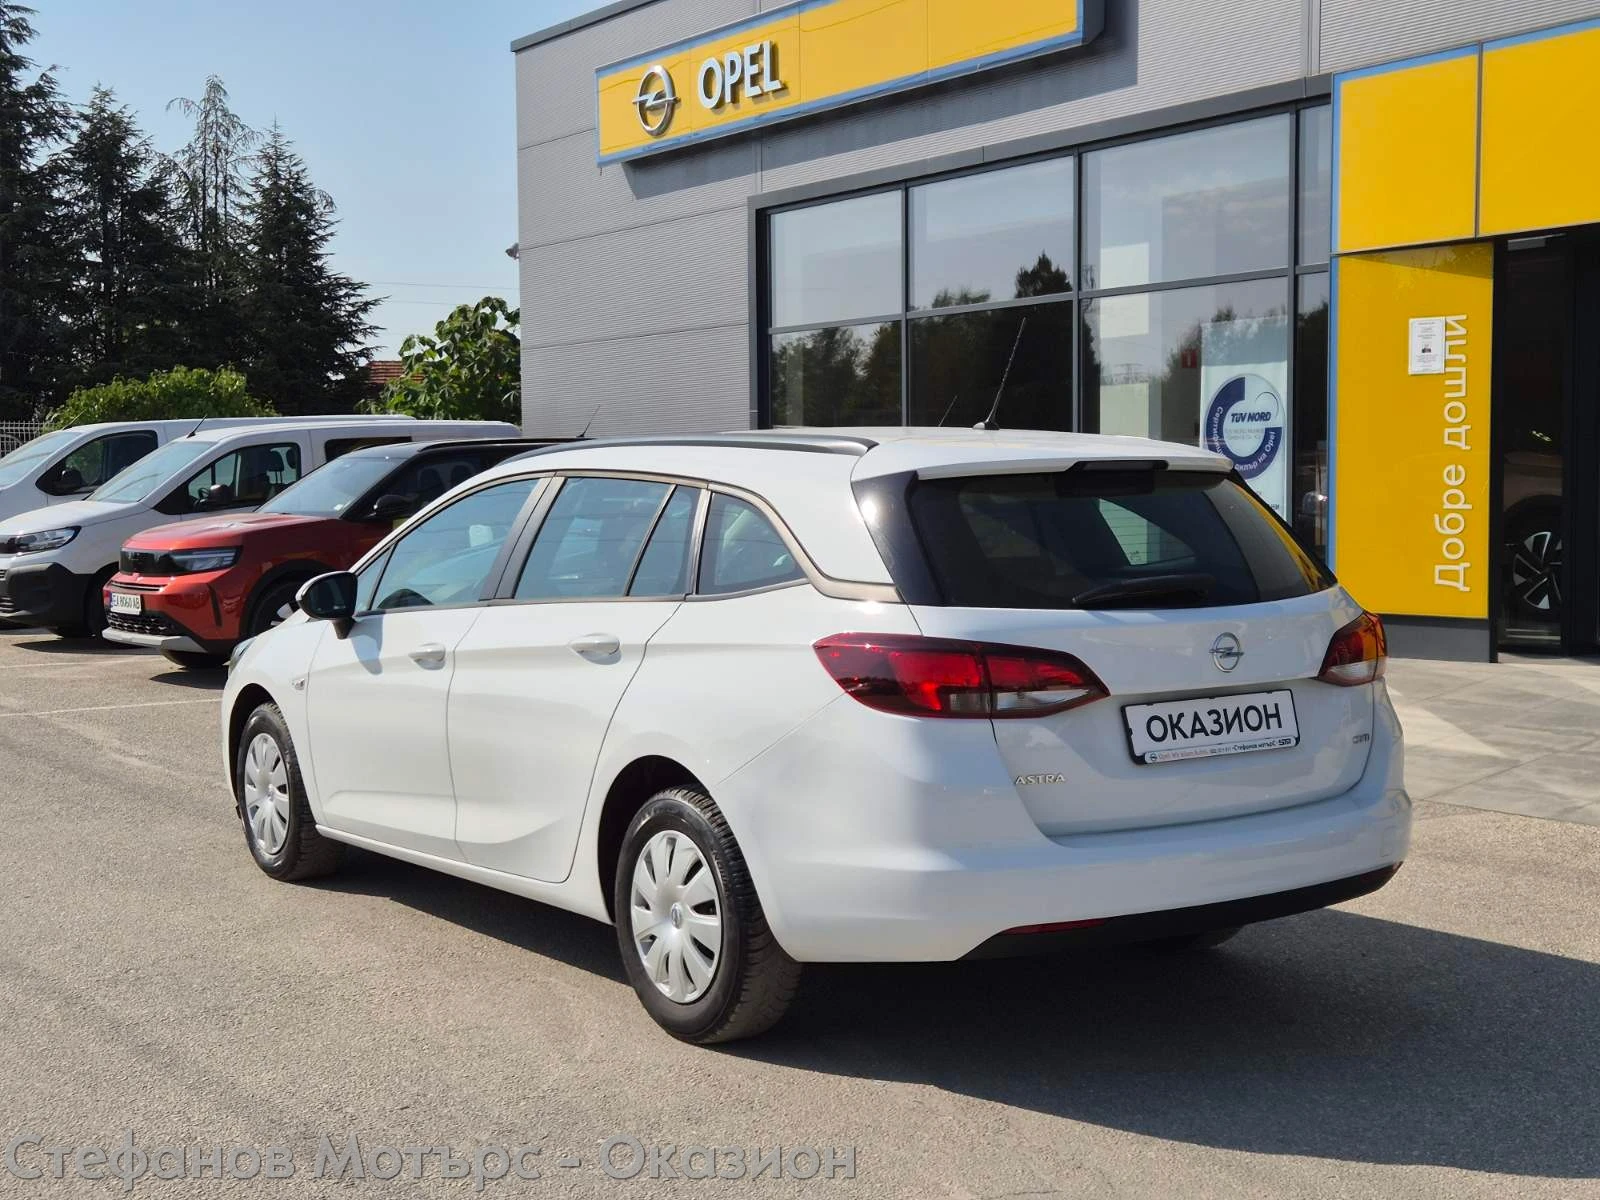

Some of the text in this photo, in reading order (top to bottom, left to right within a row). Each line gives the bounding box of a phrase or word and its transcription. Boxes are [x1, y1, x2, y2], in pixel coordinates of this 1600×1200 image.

[697, 40, 782, 108] OPEL
[1247, 411, 1272, 422] NORD
[1264, 431, 1276, 452] Opel
[1434, 314, 1473, 592] Добре дошли
[1146, 703, 1283, 743] ОКАЗИОН
[1015, 774, 1065, 785] ASTRA
